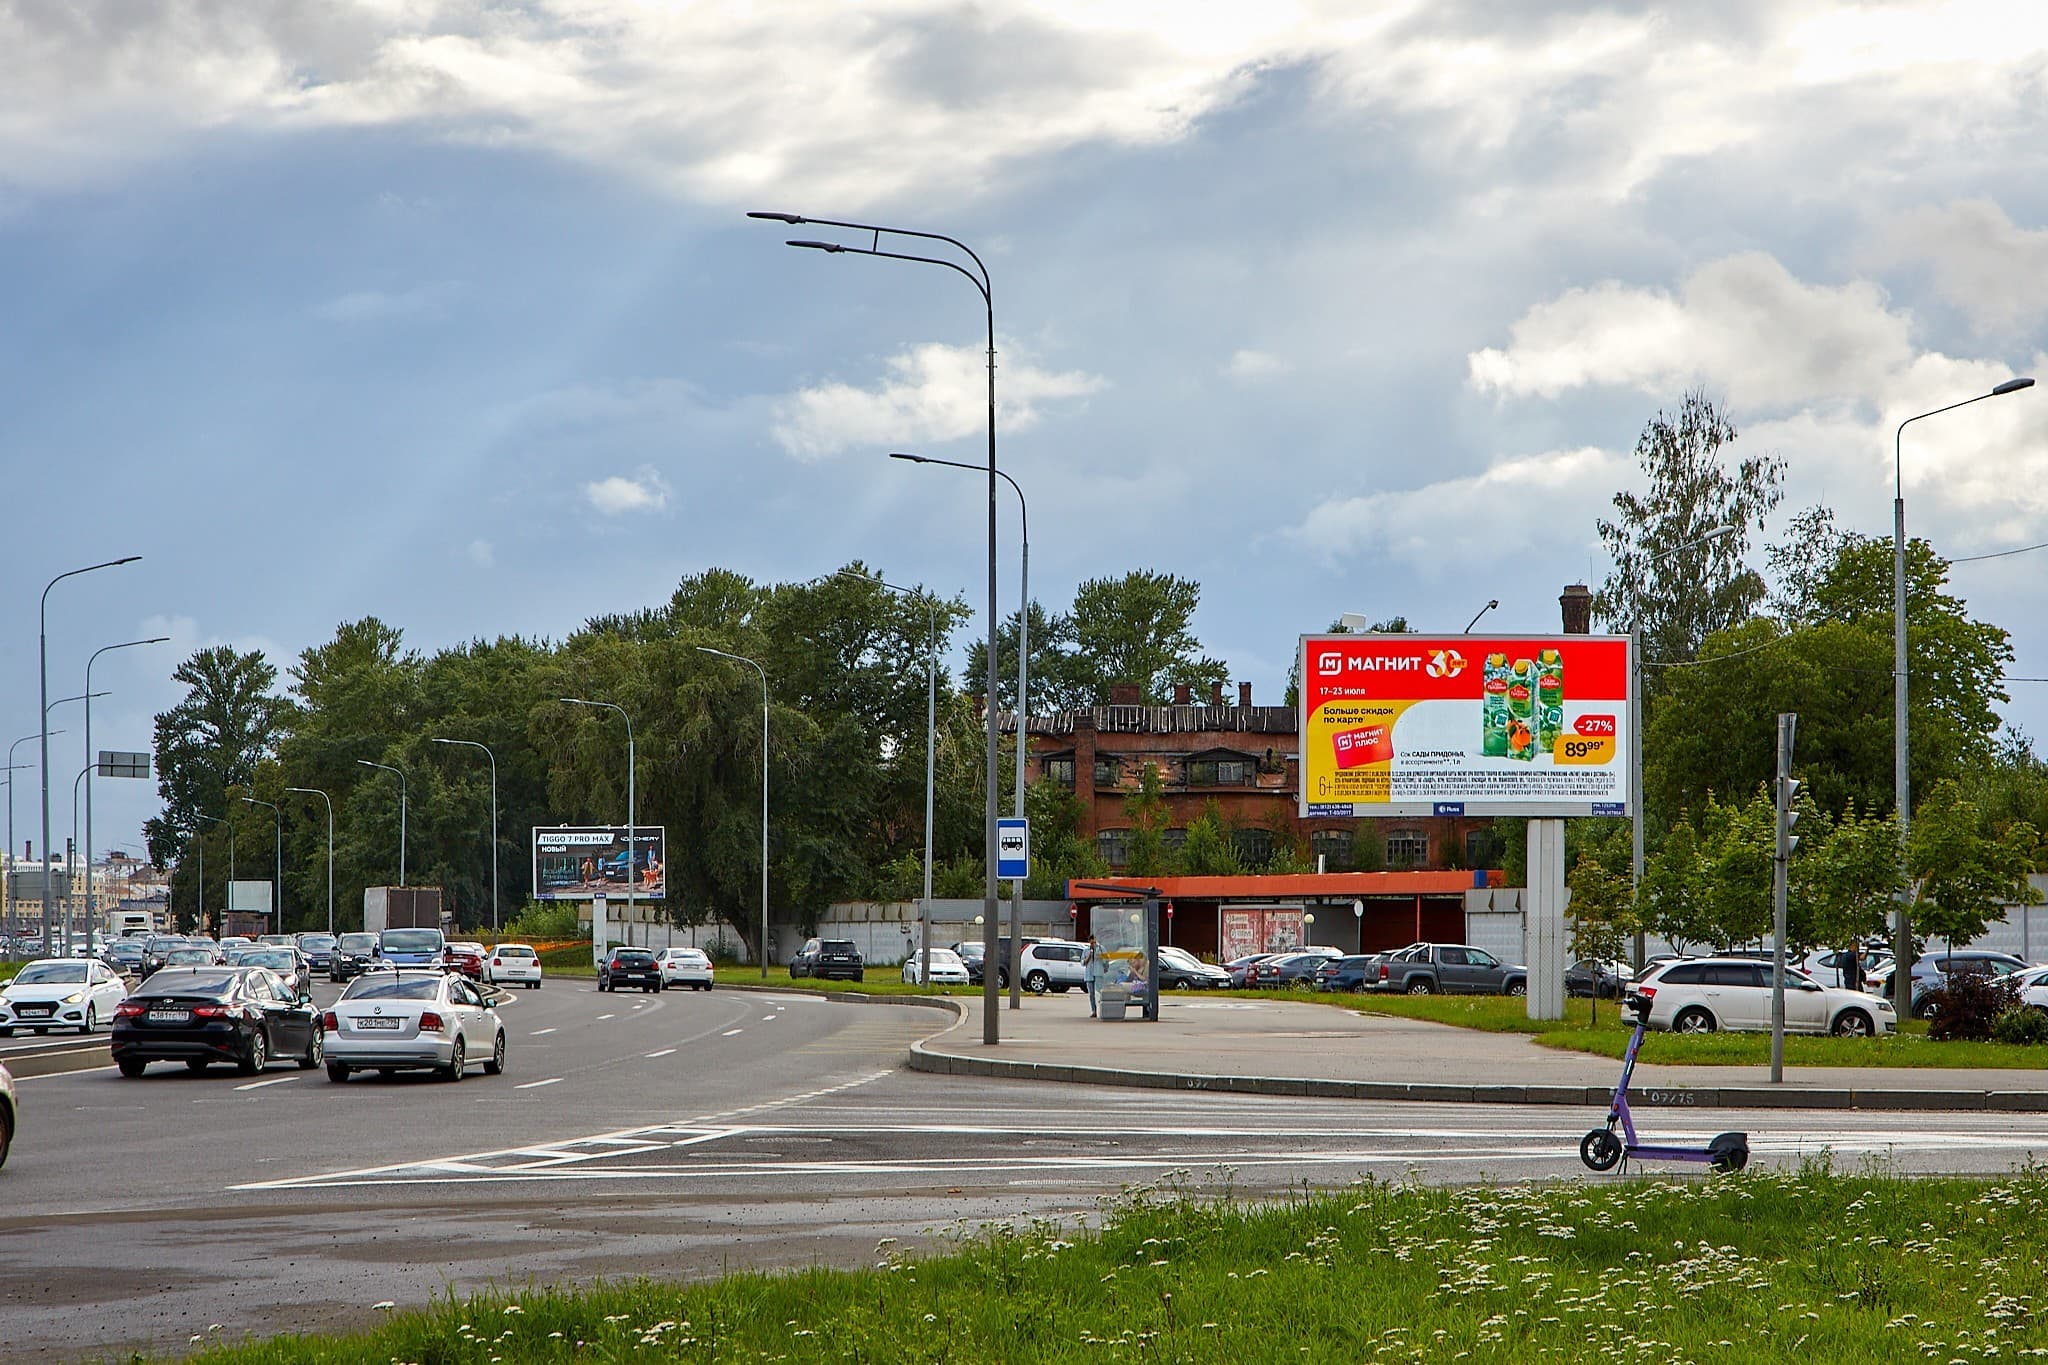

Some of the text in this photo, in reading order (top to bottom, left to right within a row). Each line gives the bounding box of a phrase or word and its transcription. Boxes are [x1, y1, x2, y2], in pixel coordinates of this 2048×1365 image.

[1348, 657, 1422, 671] МАГНИТ
[1426, 649, 1462, 678] 30
[1323, 707, 1394, 716] Больше скидок
[1577, 719, 1613, 732] -27%
[1319, 776, 1332, 796] 6+
[542, 835, 609, 843] TIGGO 7 PRO MAX
[541, 845, 567, 853] НОВЫЙ
